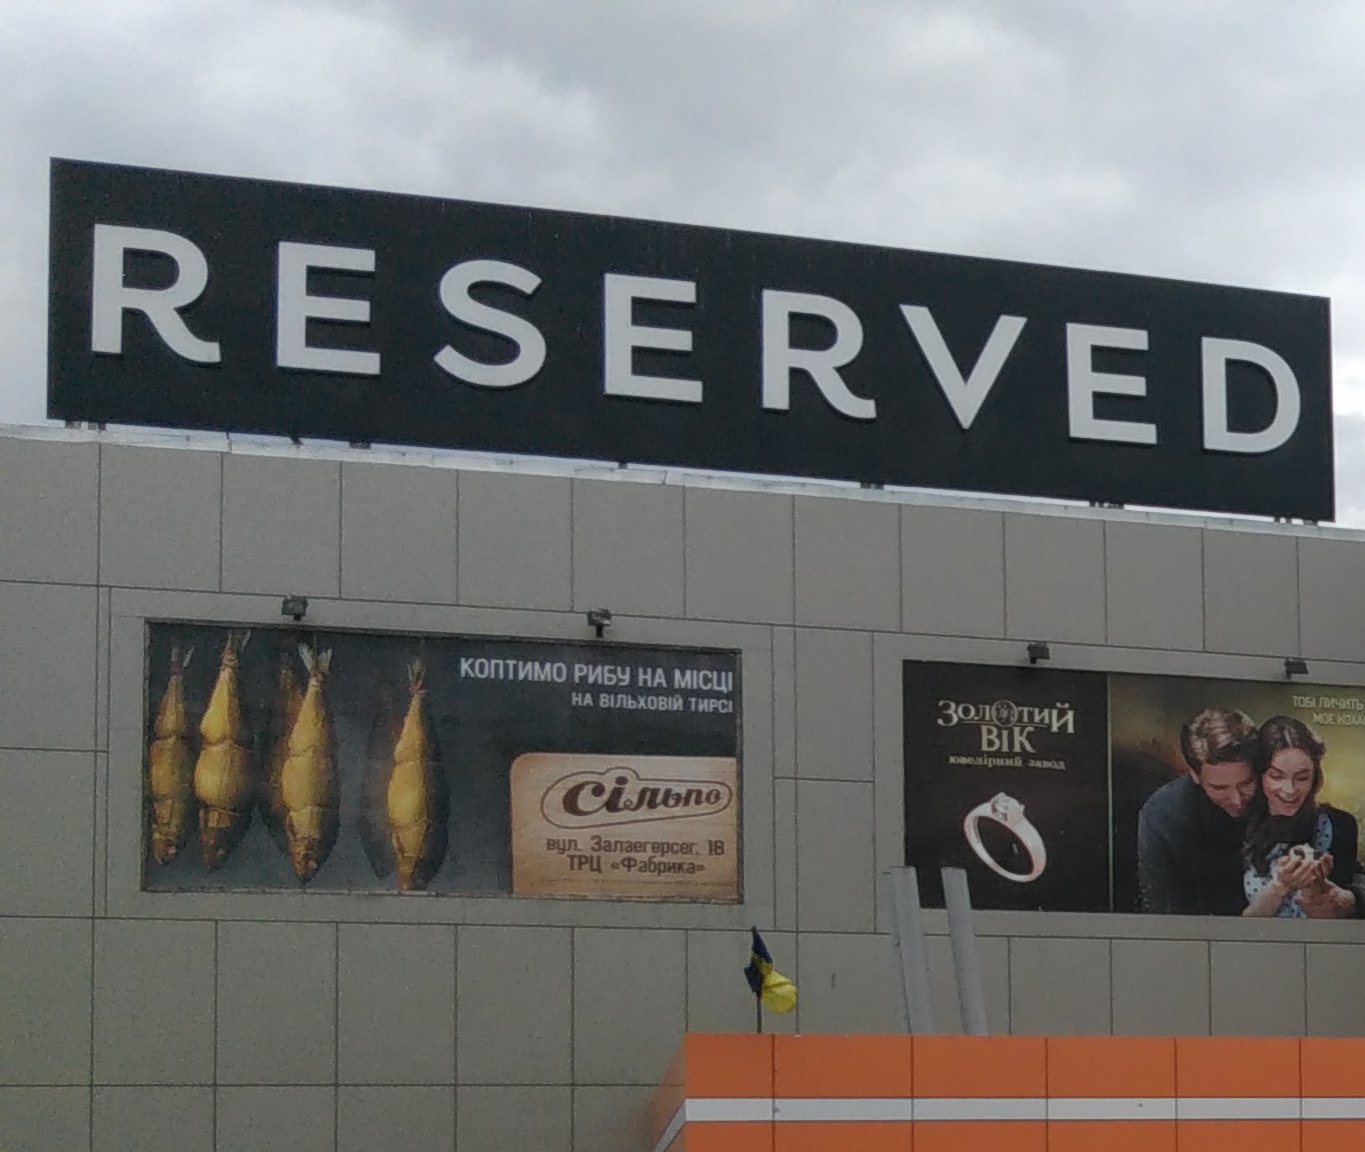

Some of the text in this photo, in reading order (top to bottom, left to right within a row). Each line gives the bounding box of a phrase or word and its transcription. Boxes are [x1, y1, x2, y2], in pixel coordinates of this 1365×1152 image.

[91, 223, 1302, 455] RESERVED
[460, 657, 733, 693] КОПТИМО РИБУ НА МІСЦІ
[571, 692, 733, 713] НА ВІЛЬХОВІЙ ТИРСІ
[1027, 758, 1067, 771] завод
[546, 838, 582, 855] вул.
[708, 840, 725, 856] 18
[567, 854, 705, 877] ТРЦ «Фабрика»
